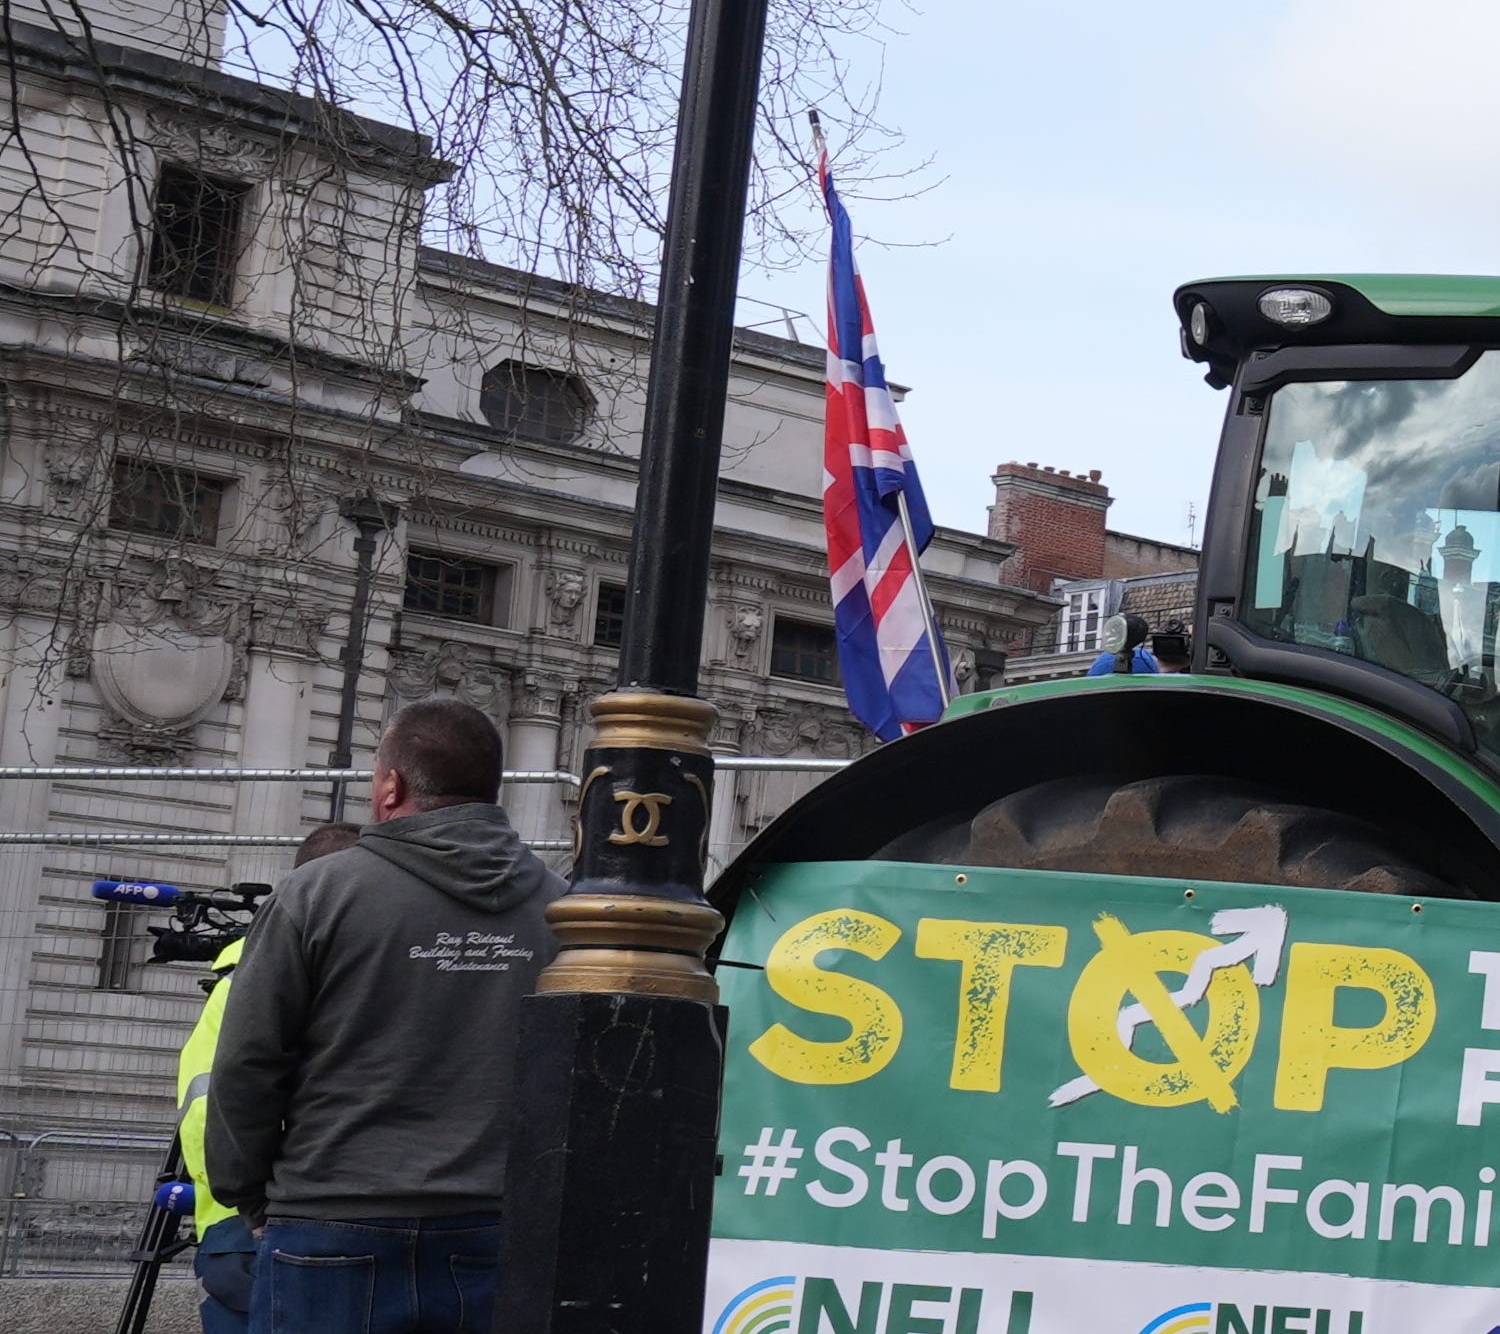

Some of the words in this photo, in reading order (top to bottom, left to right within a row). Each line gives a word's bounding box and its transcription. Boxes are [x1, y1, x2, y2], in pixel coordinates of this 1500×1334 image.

[113, 883, 144, 895] AFP
[435, 932, 463, 946] Ray
[409, 945, 463, 961] Building
[464, 946, 489, 957] and
[491, 944, 534, 961] Fencing
[436, 959, 510, 972] Maintenance
[748, 908, 1437, 1115] STOP
